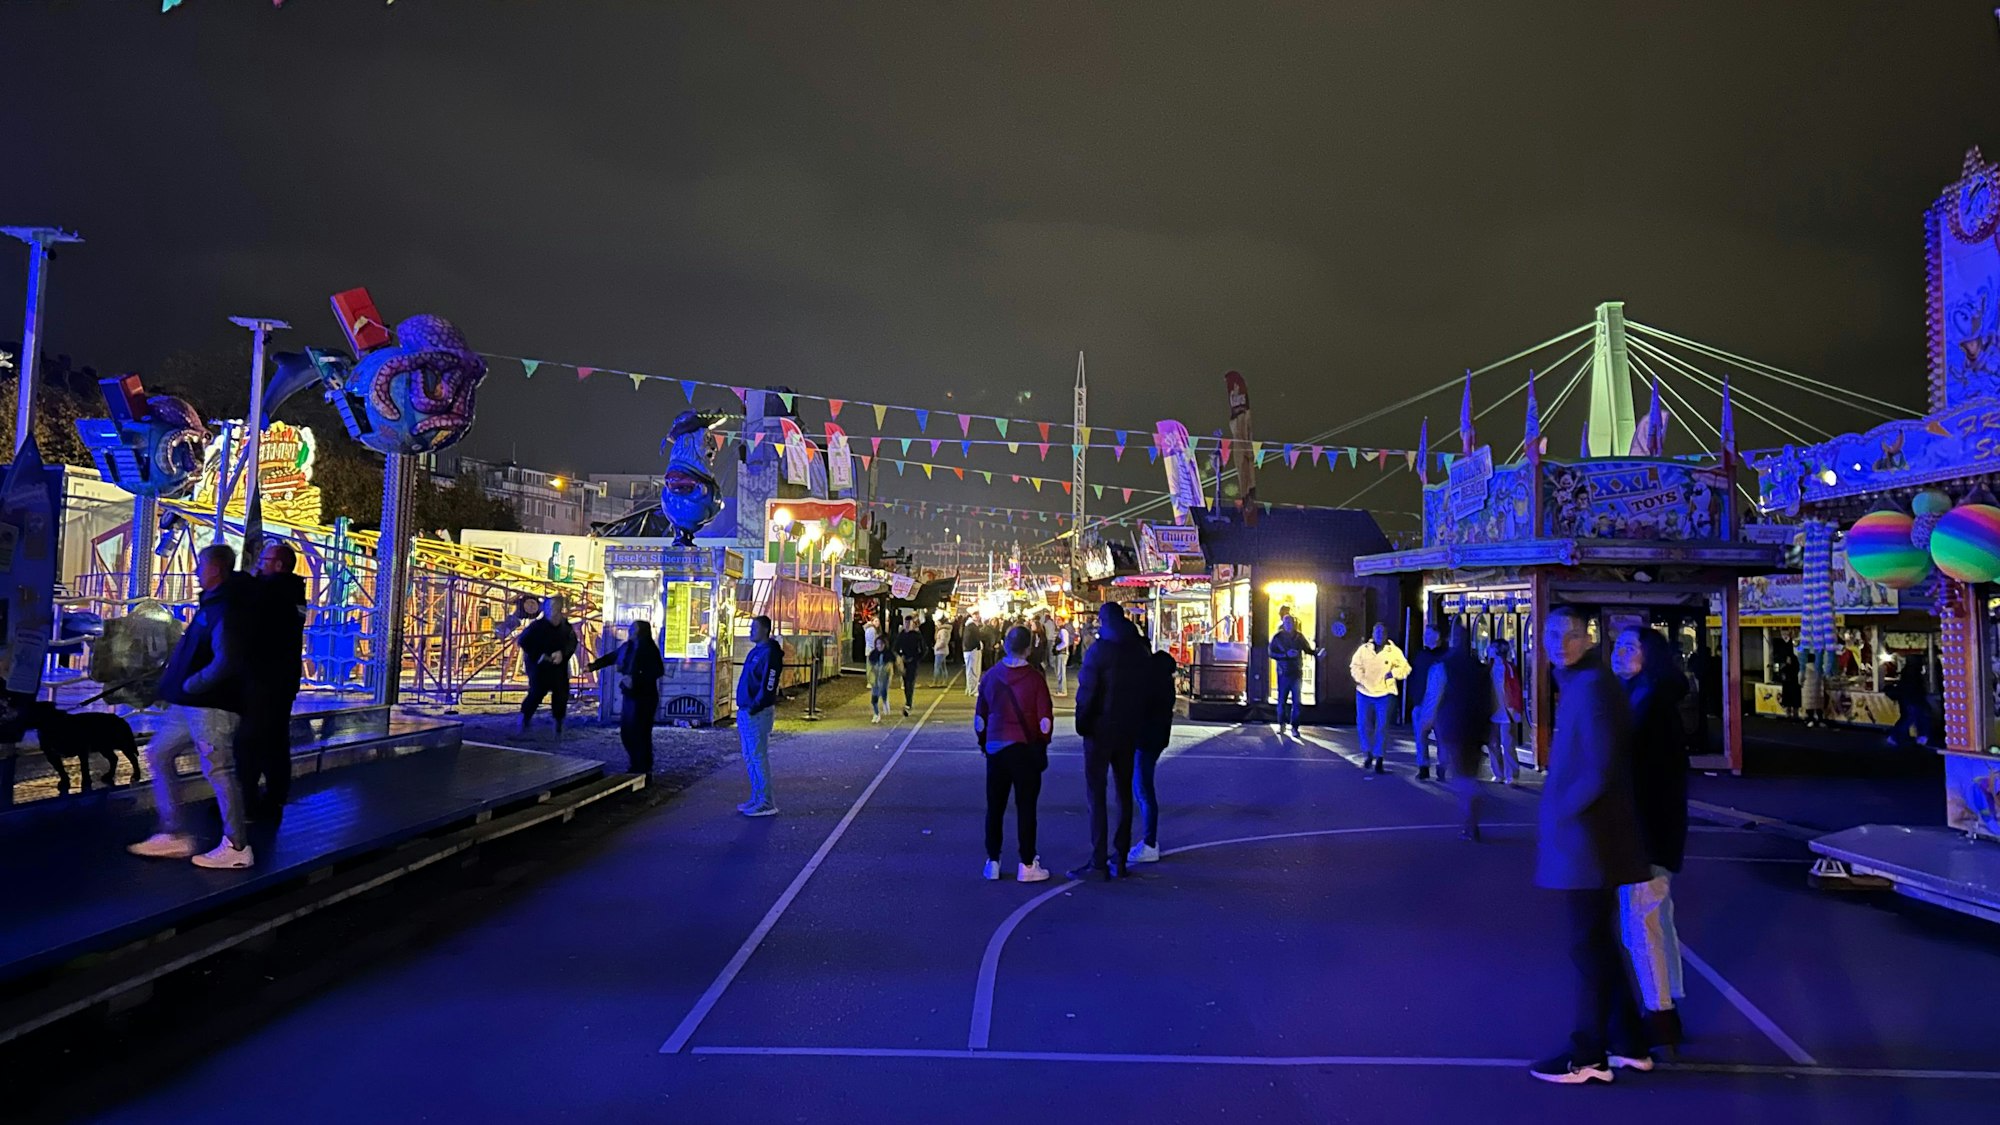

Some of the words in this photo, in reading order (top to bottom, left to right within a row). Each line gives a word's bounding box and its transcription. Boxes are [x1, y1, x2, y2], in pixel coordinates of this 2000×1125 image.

[1590, 468, 1659, 499] XXL
[1631, 491, 1678, 512] TOYS
[766, 668, 777, 692] CREW
